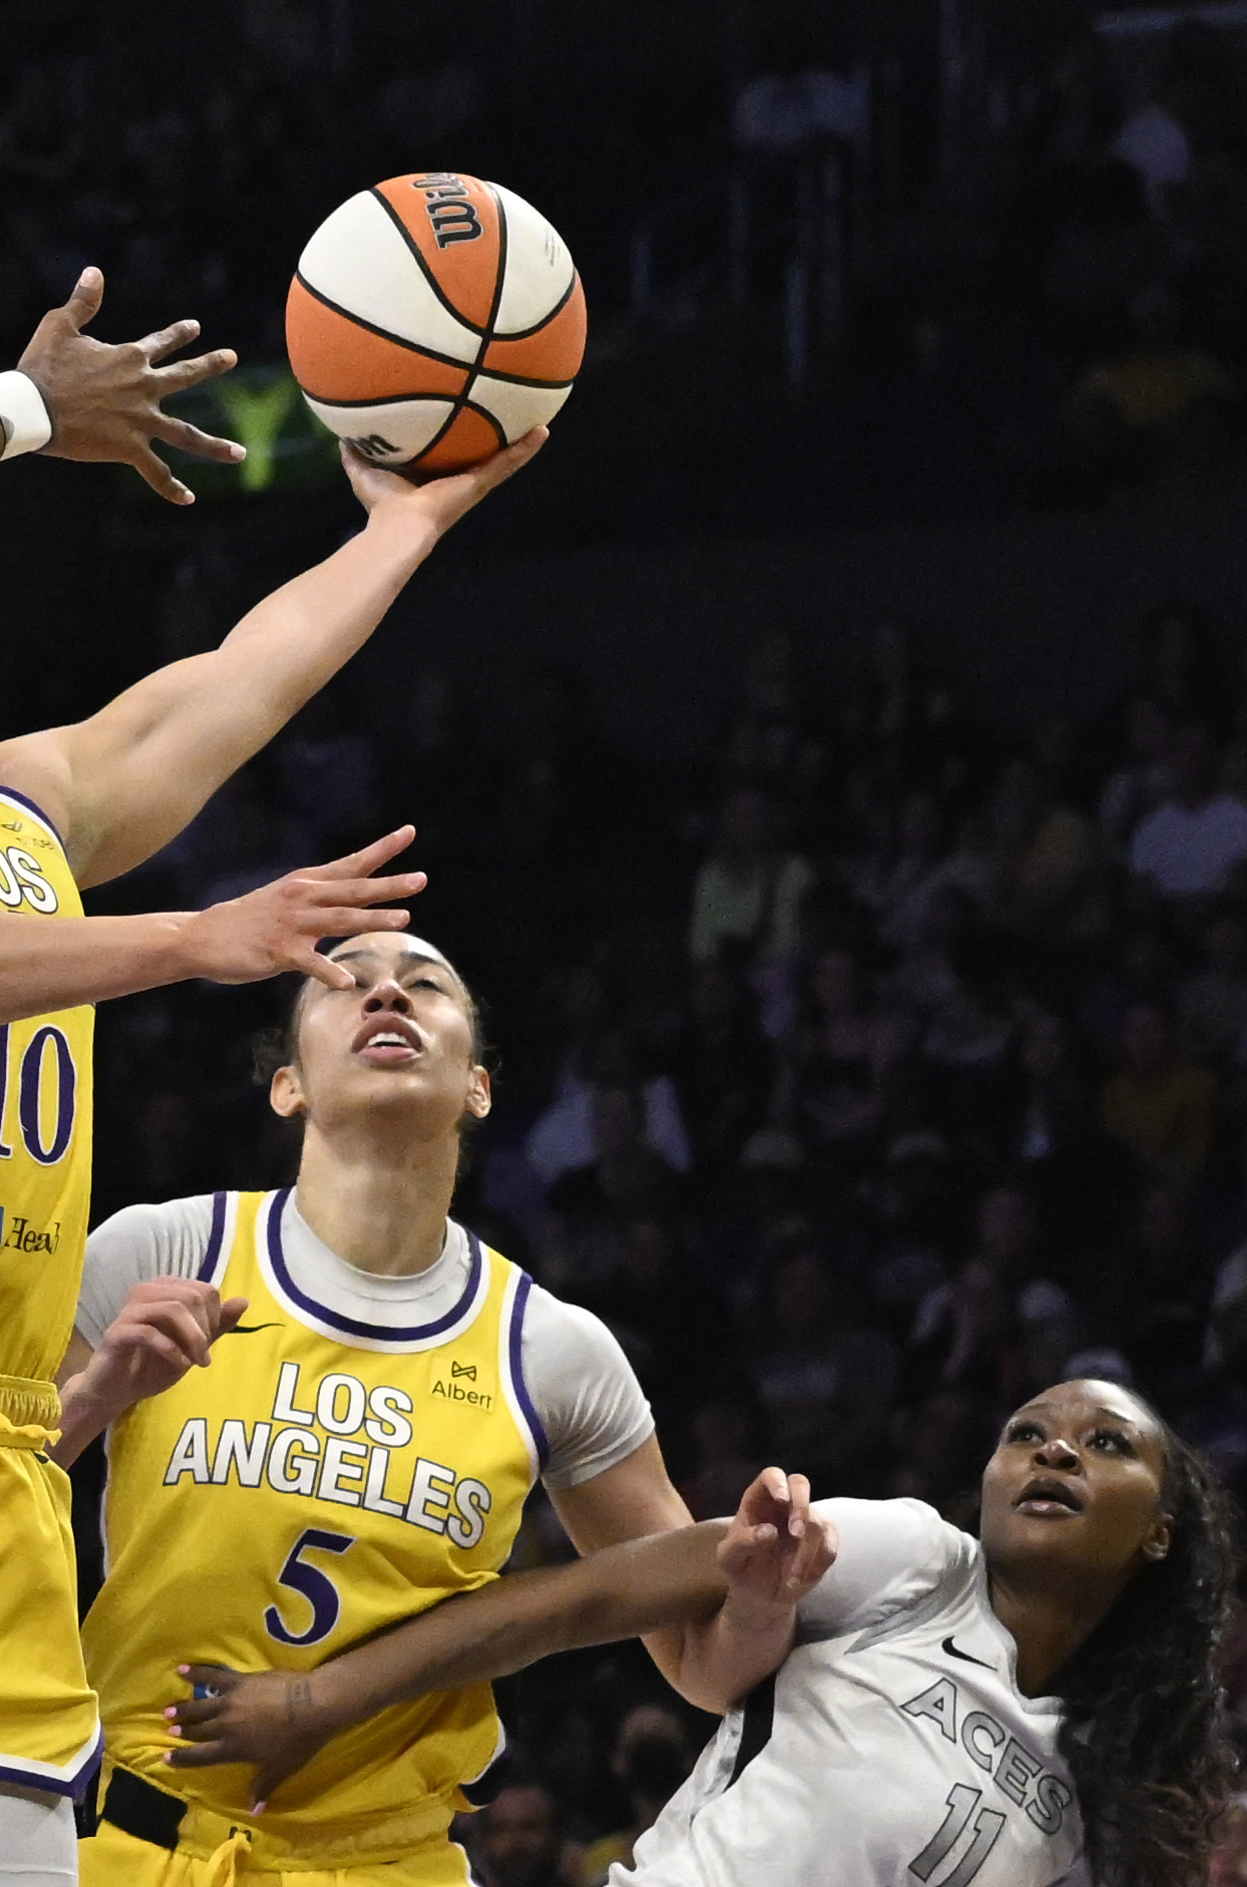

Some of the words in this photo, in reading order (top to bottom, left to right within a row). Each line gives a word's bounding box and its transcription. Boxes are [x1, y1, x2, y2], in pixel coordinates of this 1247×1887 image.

[271, 1361, 414, 1448] LOS
[431, 1380, 493, 1410] Albert
[162, 1417, 492, 1550] ANGELES
[263, 1528, 359, 1648] 5
[899, 1676, 1072, 1836] ACES
[907, 1782, 1007, 1887] 11
